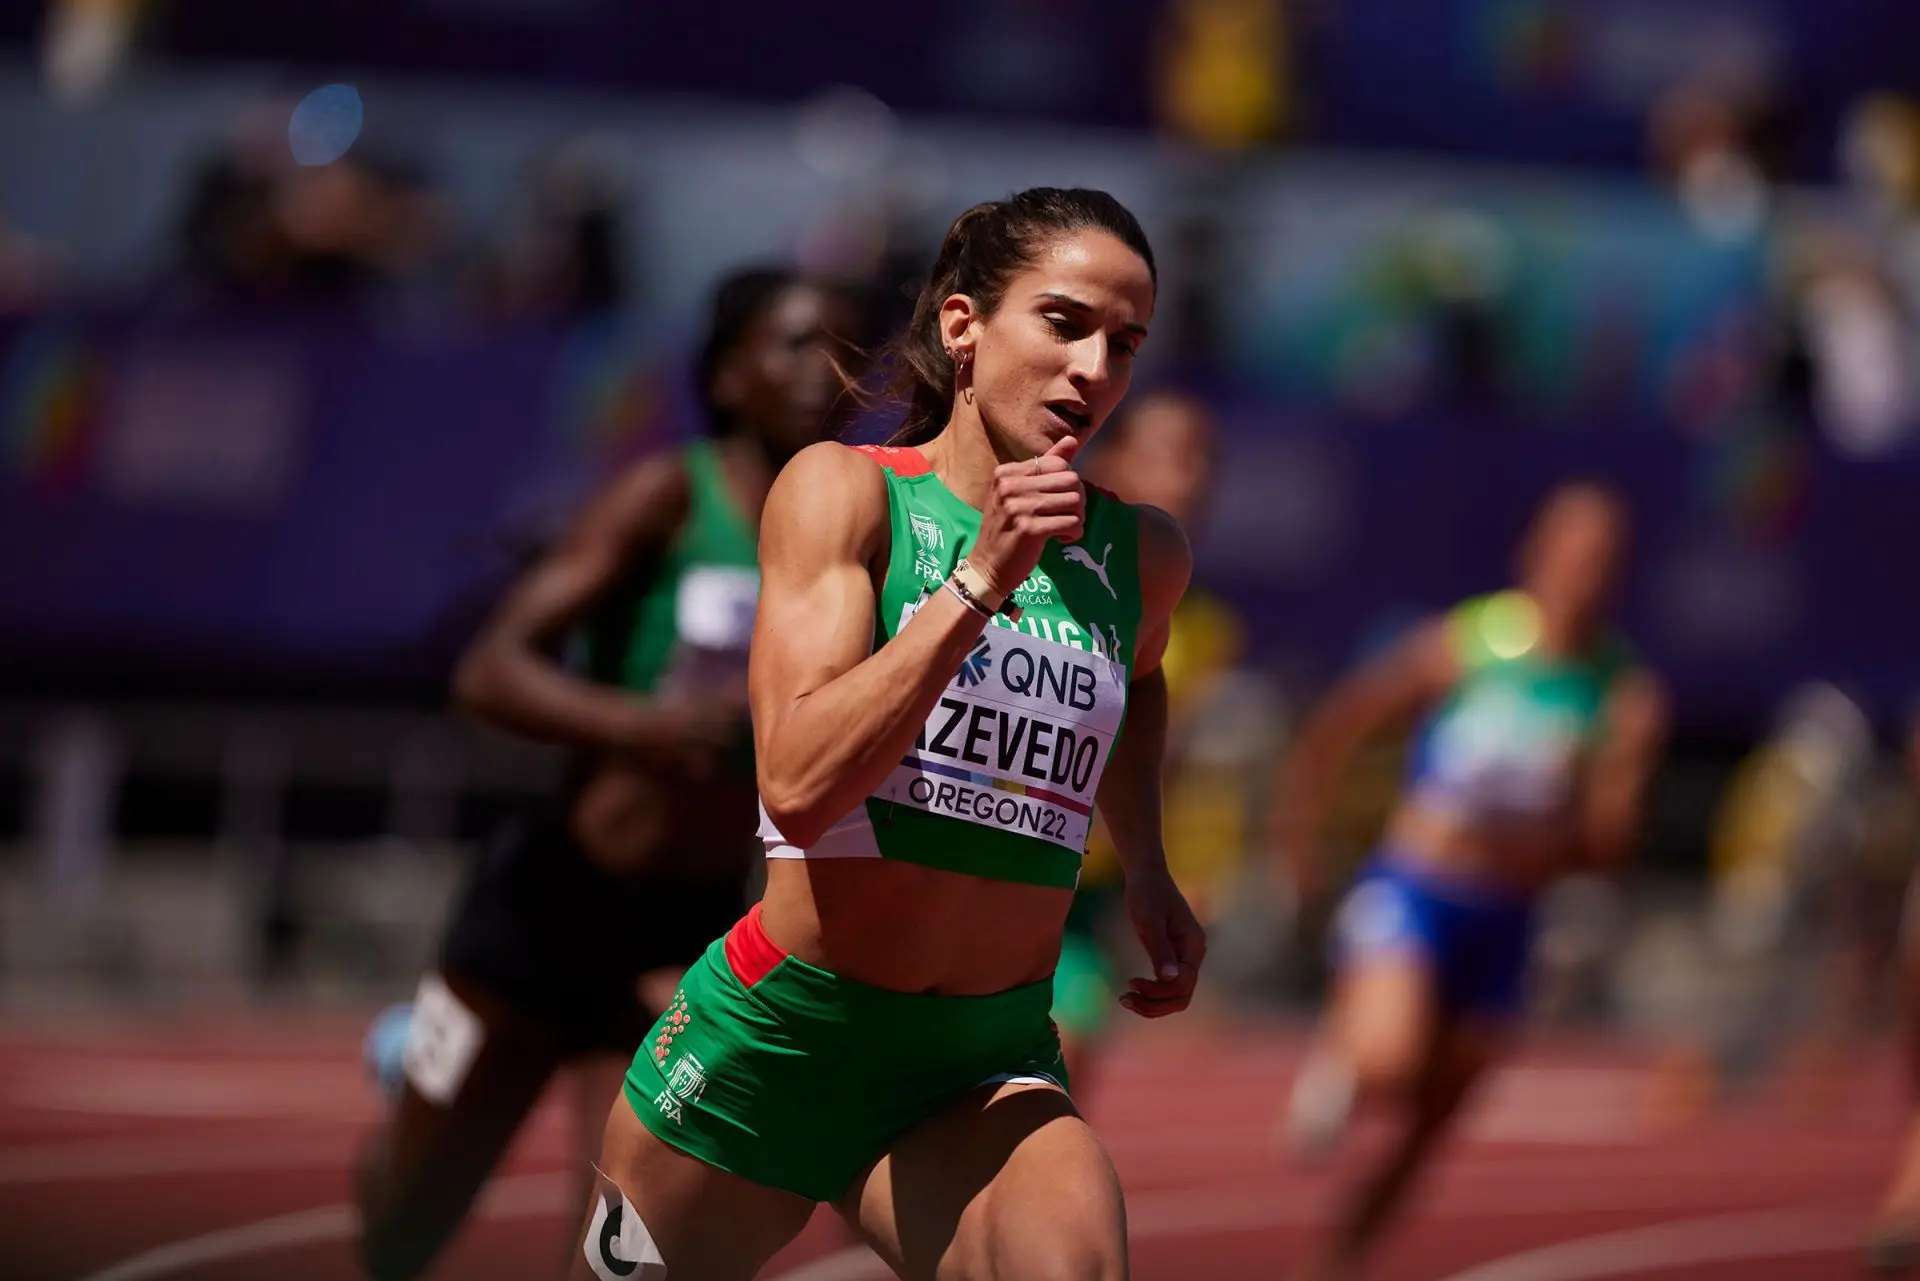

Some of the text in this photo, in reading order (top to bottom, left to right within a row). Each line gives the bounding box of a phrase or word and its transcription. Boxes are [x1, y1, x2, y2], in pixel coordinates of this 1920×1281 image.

[915, 560, 945, 582] FPA
[1001, 648, 1097, 712] QNB
[908, 776, 1067, 840] OREGON22
[654, 1091, 682, 1126] FPA
